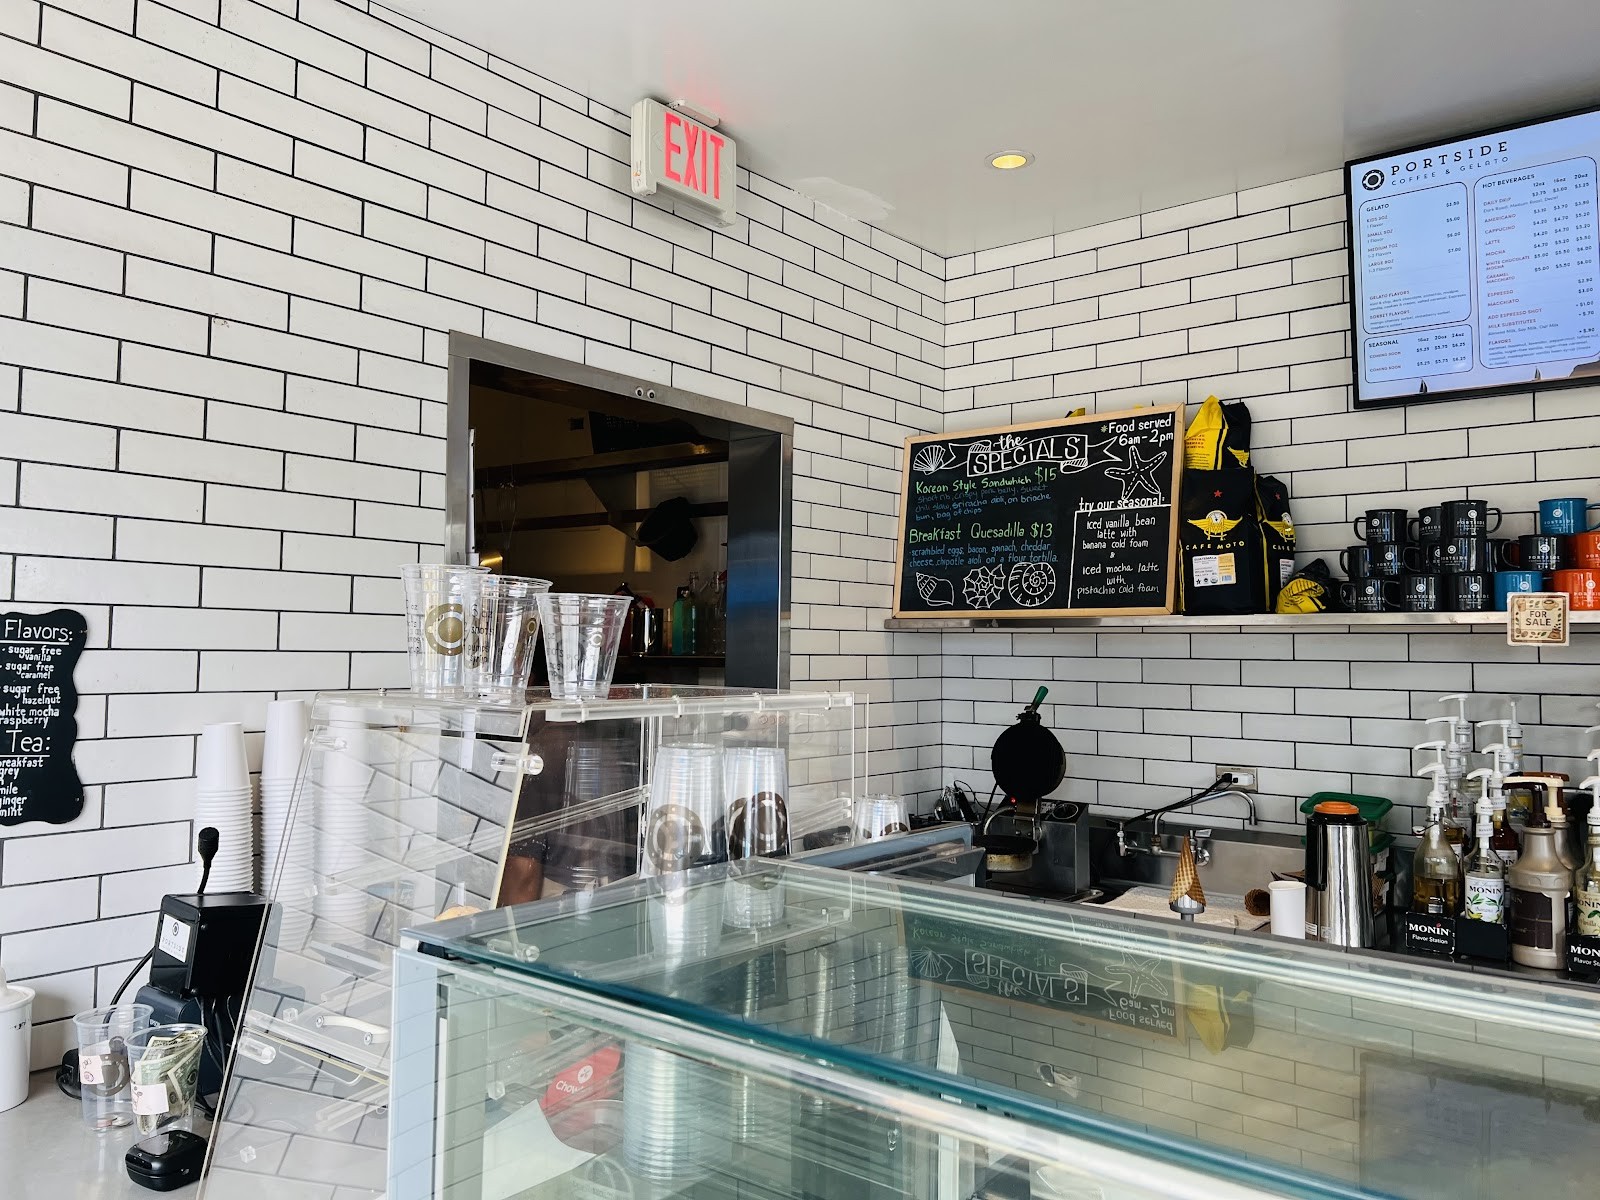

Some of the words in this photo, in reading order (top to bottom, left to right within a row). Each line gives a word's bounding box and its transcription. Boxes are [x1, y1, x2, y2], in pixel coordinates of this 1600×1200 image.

[664, 111, 724, 200] EXIT
[1392, 142, 1507, 175] PORTSIDE
[1392, 172, 1436, 186] COFFEE
[1460, 156, 1508, 171] GELATO
[1482, 181, 1495, 189] HOT
[1497, 174, 1535, 186] BEVERAGES
[1366, 203, 1390, 212] GELATO
[1369, 339, 1399, 348] SEASONAL
[1138, 413, 1172, 430] served
[994, 434, 1027, 450] the
[973, 437, 1080, 474] SPECIALS
[916, 481, 949, 494] Korean
[952, 479, 977, 494] Style
[1034, 466, 1057, 484] $15
[1020, 493, 1051, 503] brioche
[1079, 497, 1094, 517] try
[1097, 500, 1114, 510] our
[936, 512, 951, 521] bag
[1106, 514, 1130, 528] vanilla
[1135, 513, 1156, 527] bean
[971, 522, 1025, 539] Quesadilla
[1030, 522, 1053, 539] $13
[1097, 529, 1115, 539] latte
[1120, 527, 1137, 538] with
[1082, 540, 1106, 549] banana
[1111, 538, 1126, 548] cold
[1130, 538, 1149, 547] foam
[1217, 541, 1245, 550] MOTO
[986, 556, 995, 564] on
[1008, 553, 1026, 563] flour
[1106, 563, 1133, 573] mocha
[1138, 562, 1159, 573] latte
[1107, 575, 1126, 585] with
[1077, 585, 1115, 599] pistachio
[1119, 584, 1134, 594] cold
[1138, 583, 1159, 593] foam
[1526, 618, 1551, 626] SALE
[5, 618, 73, 642] Flavors:
[8, 646, 34, 659] sugar
[41, 645, 62, 655] free
[25, 653, 51, 661] vanilla
[5, 662, 32, 675] sugar
[36, 661, 54, 672] free
[21, 671, 50, 679] caramel
[3, 685, 31, 699] sugar
[38, 683, 60, 694] free
[22, 693, 60, 704] hazelnut
[29, 704, 59, 717] mocha
[6, 730, 50, 752] Tea:
[1469, 885, 1502, 895] MONIN
[1408, 923, 1450, 937] MONIN
[1412, 933, 1428, 942] Flavor
[1429, 936, 1448, 945] Station
[1570, 945, 1600, 957] MON
[1573, 957, 1592, 965] Flavor
